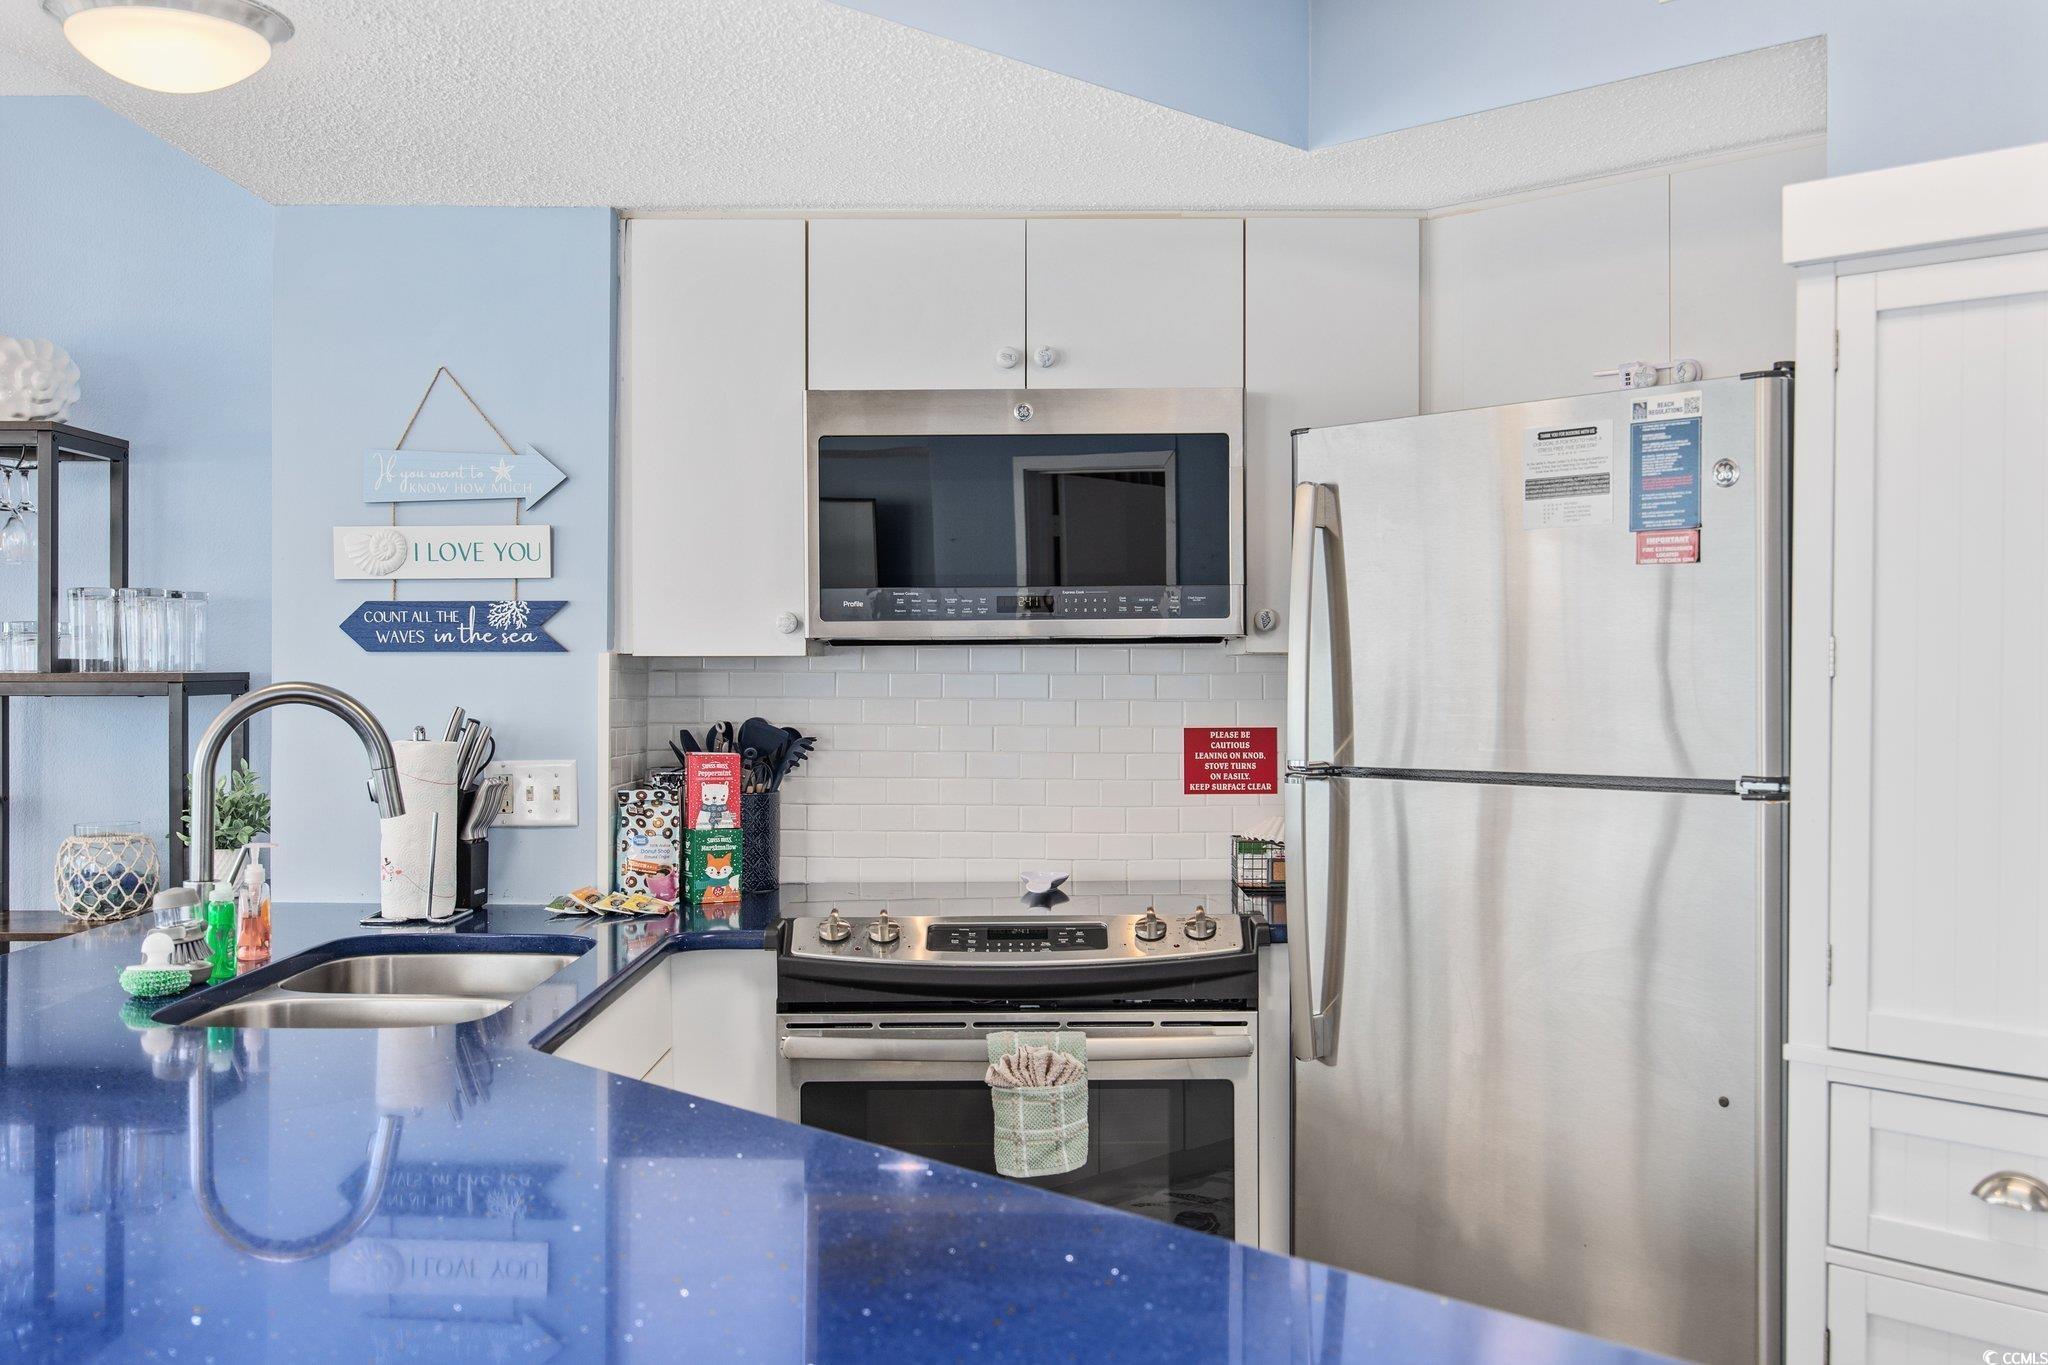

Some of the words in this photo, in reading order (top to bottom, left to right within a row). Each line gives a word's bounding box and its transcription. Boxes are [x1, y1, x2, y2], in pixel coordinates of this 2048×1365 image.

[1648, 407, 1683, 415] REGULATIONS
[373, 452, 397, 490] If
[400, 471, 426, 492] you
[430, 465, 464, 479] want
[471, 465, 484, 479] to
[409, 483, 449, 494] KNOW
[454, 483, 486, 494] HOW
[491, 482, 532, 494] MUCH
[1646, 536, 1690, 544] IMPORTANT
[414, 542, 419, 562] I
[427, 542, 485, 562] LOVE
[493, 542, 542, 562] YOU
[363, 610, 408, 623] COUNT
[411, 611, 433, 623] ALL
[436, 610, 460, 623] THE
[376, 630, 425, 644] WAVES
[434, 628, 456, 643] in
[457, 606, 498, 644] the
[502, 631, 538, 644] sea
[1210, 731, 1239, 739] PLEASE
[1240, 731, 1251, 739] BE
[1210, 741, 1250, 749] CAUTIOUS
[1195, 752, 1228, 760] LEANING
[1204, 762, 1229, 770] STOVE
[1230, 762, 1257, 770] TURNS
[697, 770, 732, 778] Peppermint
[1210, 772, 1221, 780] ON
[1223, 772, 1251, 780] EASILY.
[1189, 783, 1210, 791] KEEP
[1211, 783, 1246, 791] SURFACE
[1247, 783, 1272, 791] CLEAR
